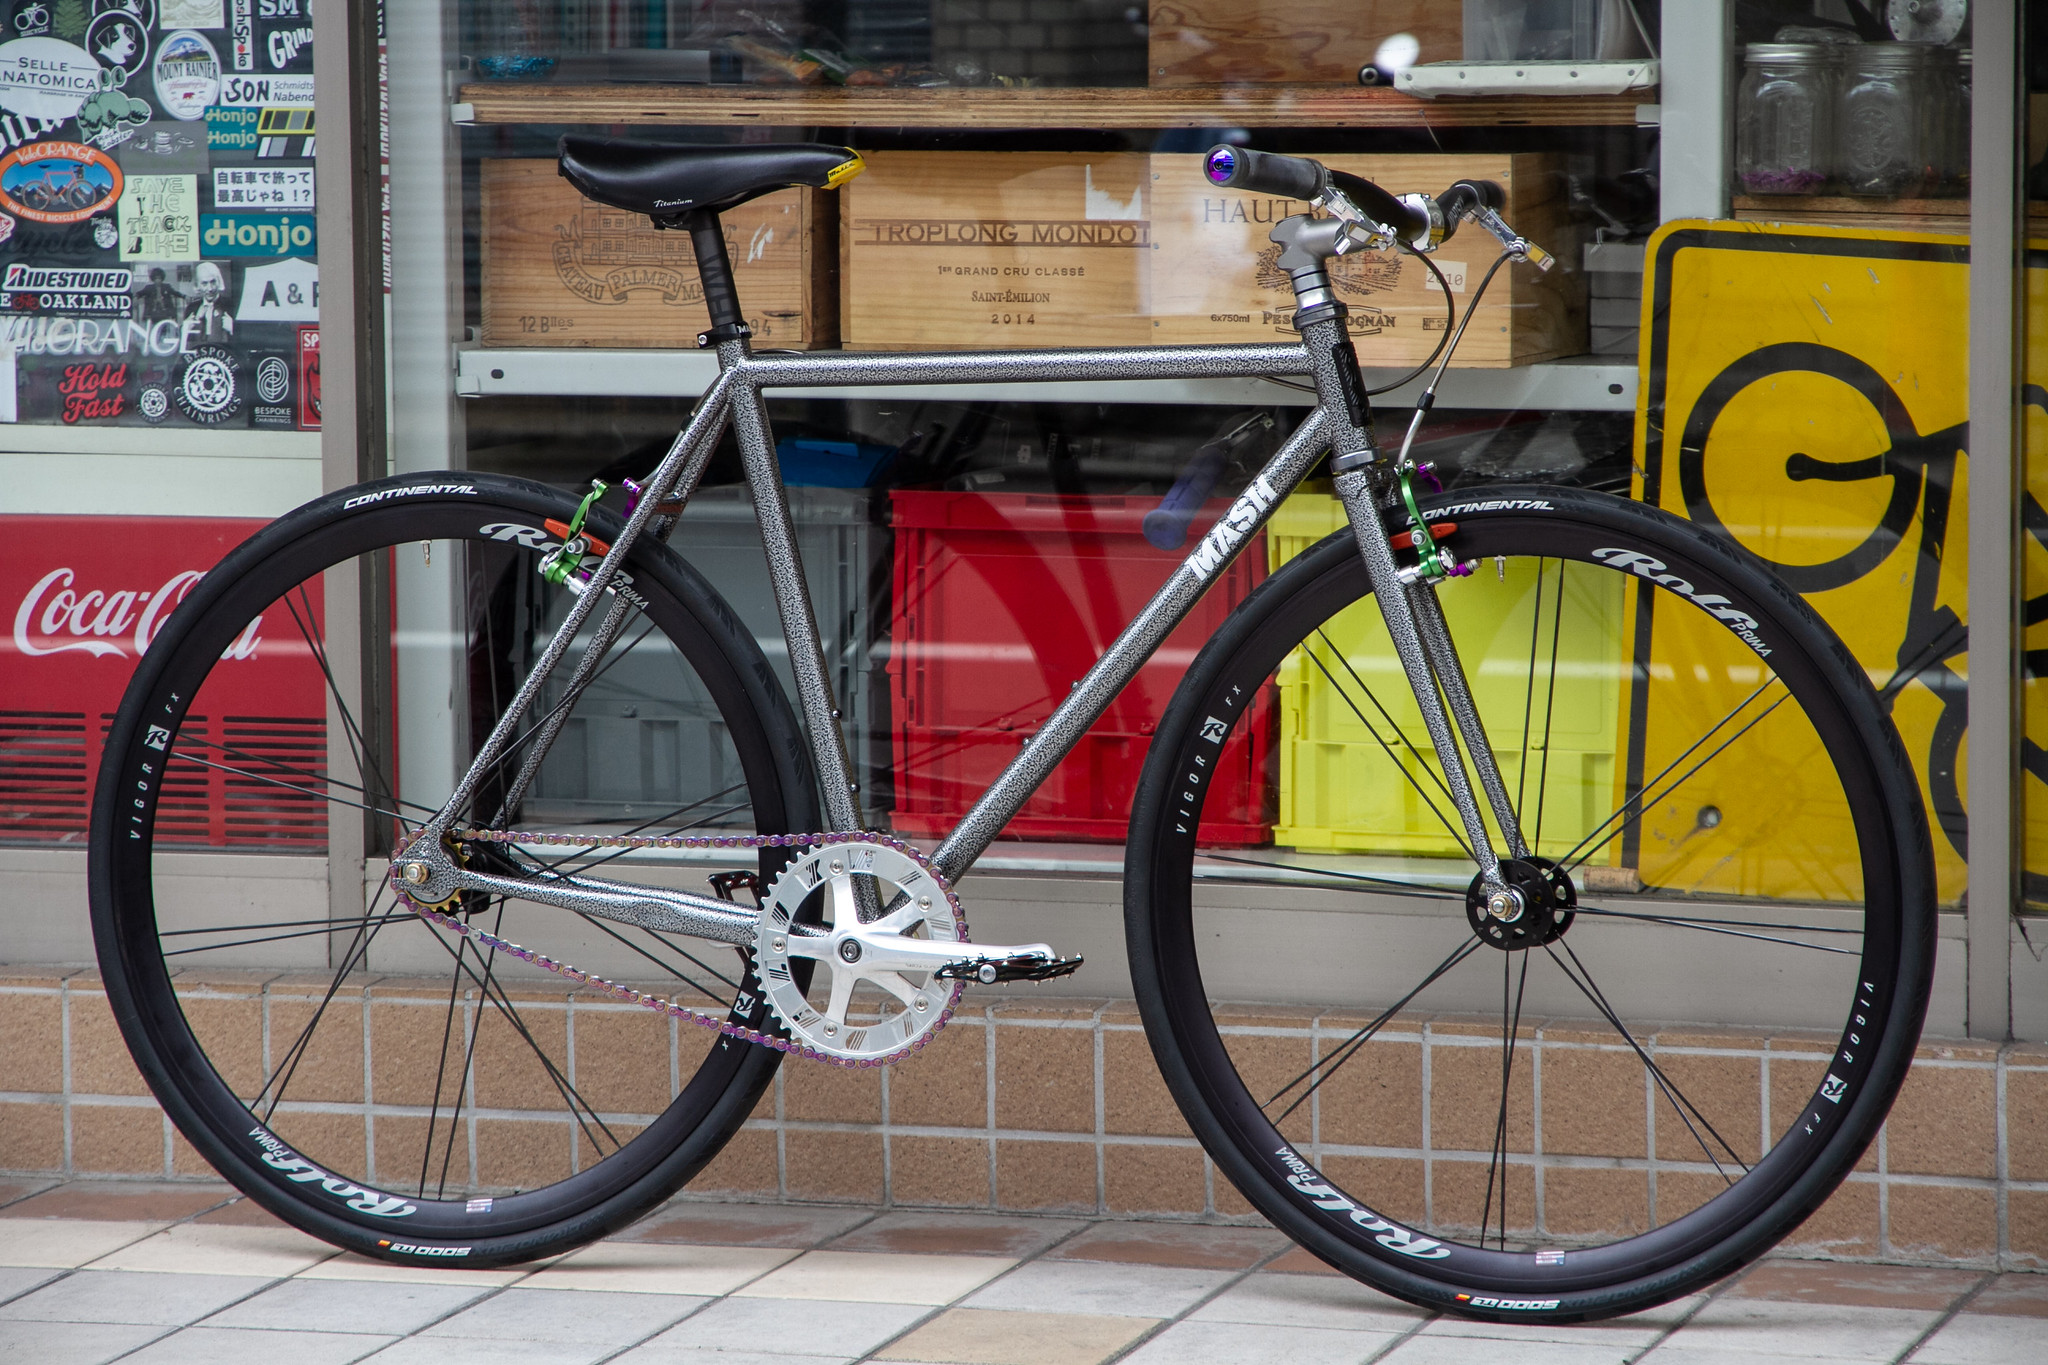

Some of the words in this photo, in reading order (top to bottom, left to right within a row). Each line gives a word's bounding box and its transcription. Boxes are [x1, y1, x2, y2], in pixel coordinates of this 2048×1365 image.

[18, 56, 69, 72] SELLE
[157, 62, 183, 82] MOUNT
[186, 61, 219, 80] RAINIER
[0, 70, 97, 90] NATOMICA
[225, 77, 270, 103] SON
[273, 80, 314, 90] Schmidts
[205, 108, 257, 126] Honjo
[207, 129, 257, 148] Honjo
[130, 177, 185, 194] SAVE
[217, 171, 310, 184] 自転車で旅って
[7, 201, 21, 213] THE
[20, 207, 45, 220] FINEST
[46, 213, 75, 222] BICYCLE
[137, 194, 180, 216] THE
[653, 198, 693, 208] Titanium
[1203, 199, 1296, 223] HAUT
[126, 215, 192, 235] TRACK
[204, 217, 312, 254] Honjo
[868, 223, 1018, 243] TROPLONG
[1032, 223, 1150, 244] MONDOT
[127, 233, 189, 258] BIKE
[556, 246, 606, 300] CHATEAU
[610, 269, 678, 292] PALMER
[955, 267, 999, 277] GRAND
[1003, 267, 1030, 277] CRU
[1035, 265, 1086, 277] CLASSÉ
[40, 294, 132, 310] OAKLAND
[260, 280, 280, 307] A
[287, 283, 304, 304] &
[972, 288, 1051, 304] SAINT-ÉMILION
[520, 316, 536, 333] 12
[991, 313, 1036, 326] 2014
[1210, 313, 1251, 324] 6x750ml
[183, 346, 241, 372] BESPOKE
[59, 363, 127, 392] Hold
[62, 390, 124, 422] Fast
[174, 386, 242, 423] CHAINRINGS
[255, 407, 291, 416] BESPOKE
[255, 416, 291, 424] CHAINRINGS
[343, 484, 478, 511] CONTINENTAL
[610, 580, 650, 611] PRIMA
[13, 567, 263, 661] Coca-Ca
[1730, 622, 1773, 658] PRIMA
[130, 763, 153, 839] VIGOR
[165, 692, 180, 713] FX
[1176, 755, 1206, 834] VIGOR
[1225, 684, 1241, 707] FX
[1843, 981, 1874, 1064] VIGOR
[248, 1126, 289, 1158] PRIMA
[1274, 1146, 1317, 1183] PRIMA
[414, 1245, 472, 1257] 5000
[1497, 1299, 1560, 1310] 5000
